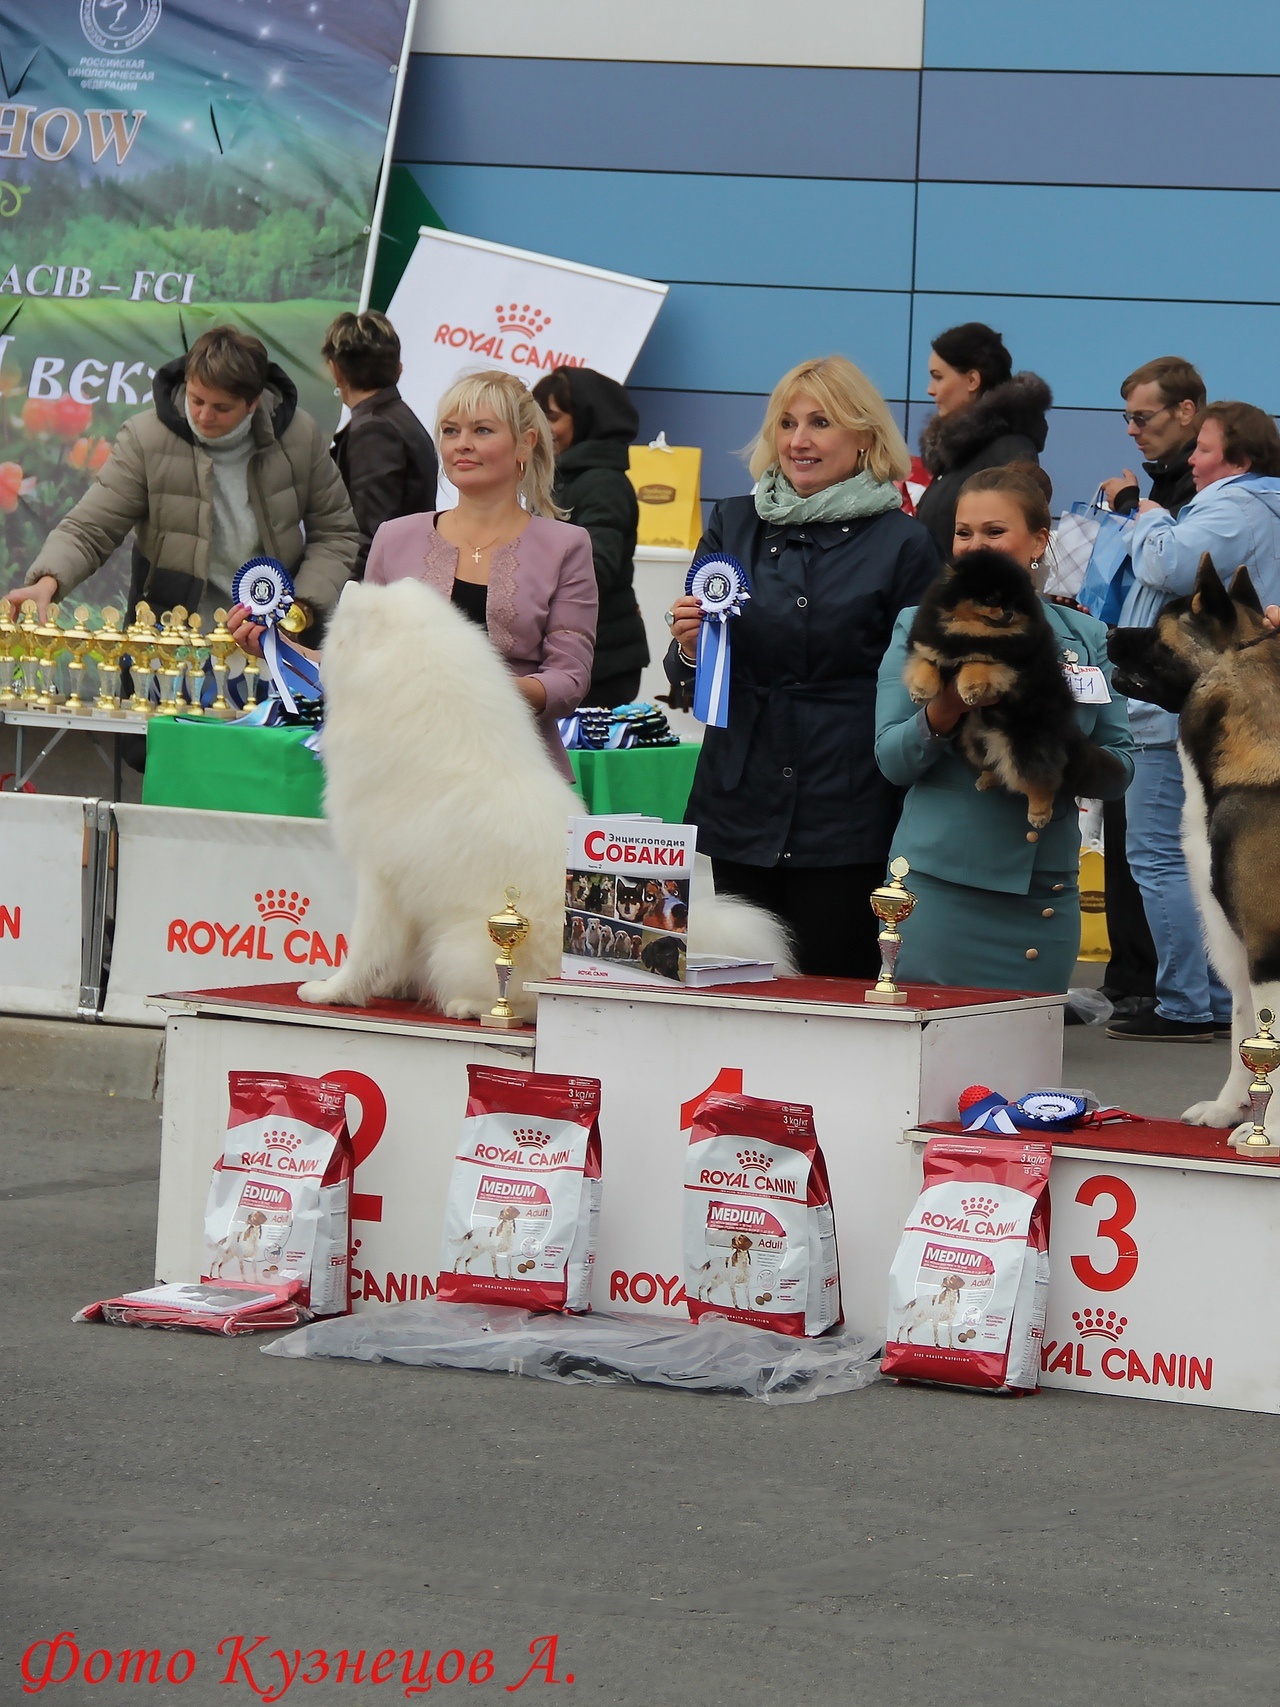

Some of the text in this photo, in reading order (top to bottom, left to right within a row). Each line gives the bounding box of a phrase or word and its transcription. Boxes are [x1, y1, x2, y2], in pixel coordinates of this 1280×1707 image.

[0, 103, 147, 165] HOW
[0, 263, 92, 298] ACIB
[129, 270, 196, 304] FCI
[434, 323, 504, 361] ROYAL
[608, 833, 685, 848] Энциклопедия
[167, 919, 348, 967] ROYAL CAN
[568, 1088, 574, 1098] 3
[783, 1115, 788, 1124] 3
[475, 1143, 571, 1166] ROYAL CANIN
[1021, 1153, 1026, 1163] 3
[481, 1180, 537, 1198] MEDIUM
[700, 1169, 750, 1189] ROYAL
[754, 1175, 796, 1195] CANIN
[242, 1184, 285, 1204] EDIUM
[525, 1208, 549, 1218] Adult
[711, 1206, 767, 1226] MEDIUM
[920, 1211, 970, 1233] ROYAL
[974, 1220, 1018, 1237] CANIN
[1070, 1173, 1139, 1293] 3
[758, 1239, 783, 1250] Adult
[925, 1247, 983, 1268] MEDIUM
[970, 1278, 992, 1288] Adult
[1041, 1340, 1213, 1391] YAL CANIN
